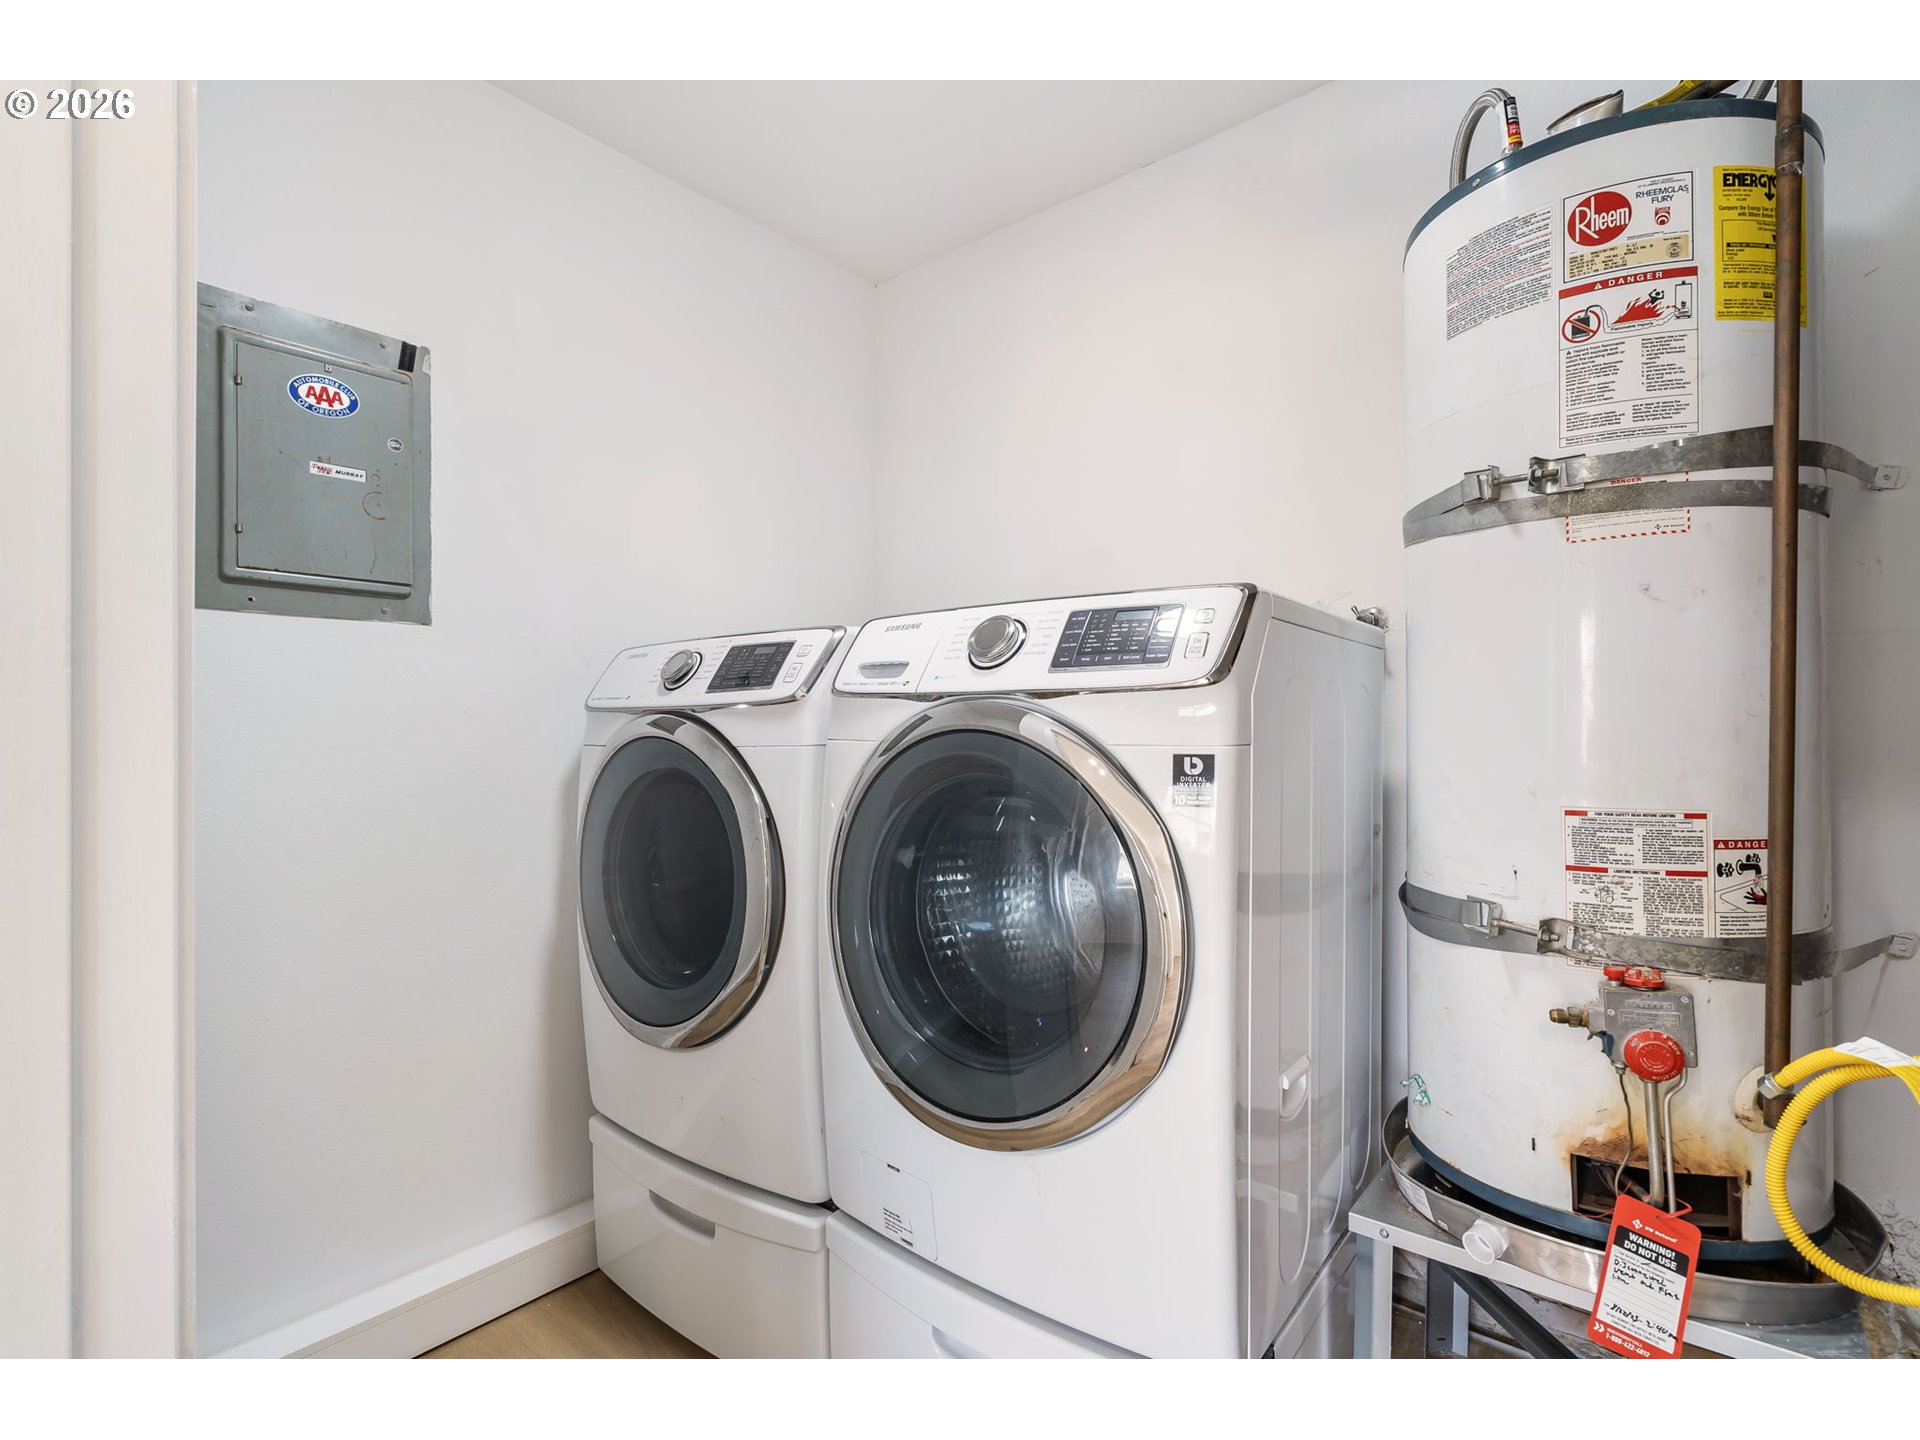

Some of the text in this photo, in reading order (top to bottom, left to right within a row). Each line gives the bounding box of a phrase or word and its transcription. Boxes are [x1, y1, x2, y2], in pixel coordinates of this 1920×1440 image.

[1636, 184, 1689, 199] RHEEMGLAS
[1651, 194, 1674, 204] FURY
[1575, 196, 1629, 242] Rheem
[1608, 271, 1664, 287] DANGER
[293, 376, 356, 401] AUTOMOBILE CLUB
[305, 385, 344, 408] AAA
[298, 398, 350, 416] OF OREGON
[335, 469, 364, 479] MURRAY
[884, 622, 922, 633] SAMSUNG
[1629, 1232, 1676, 1260] WARNING!
[1624, 1240, 1678, 1271] DO NOT USE
